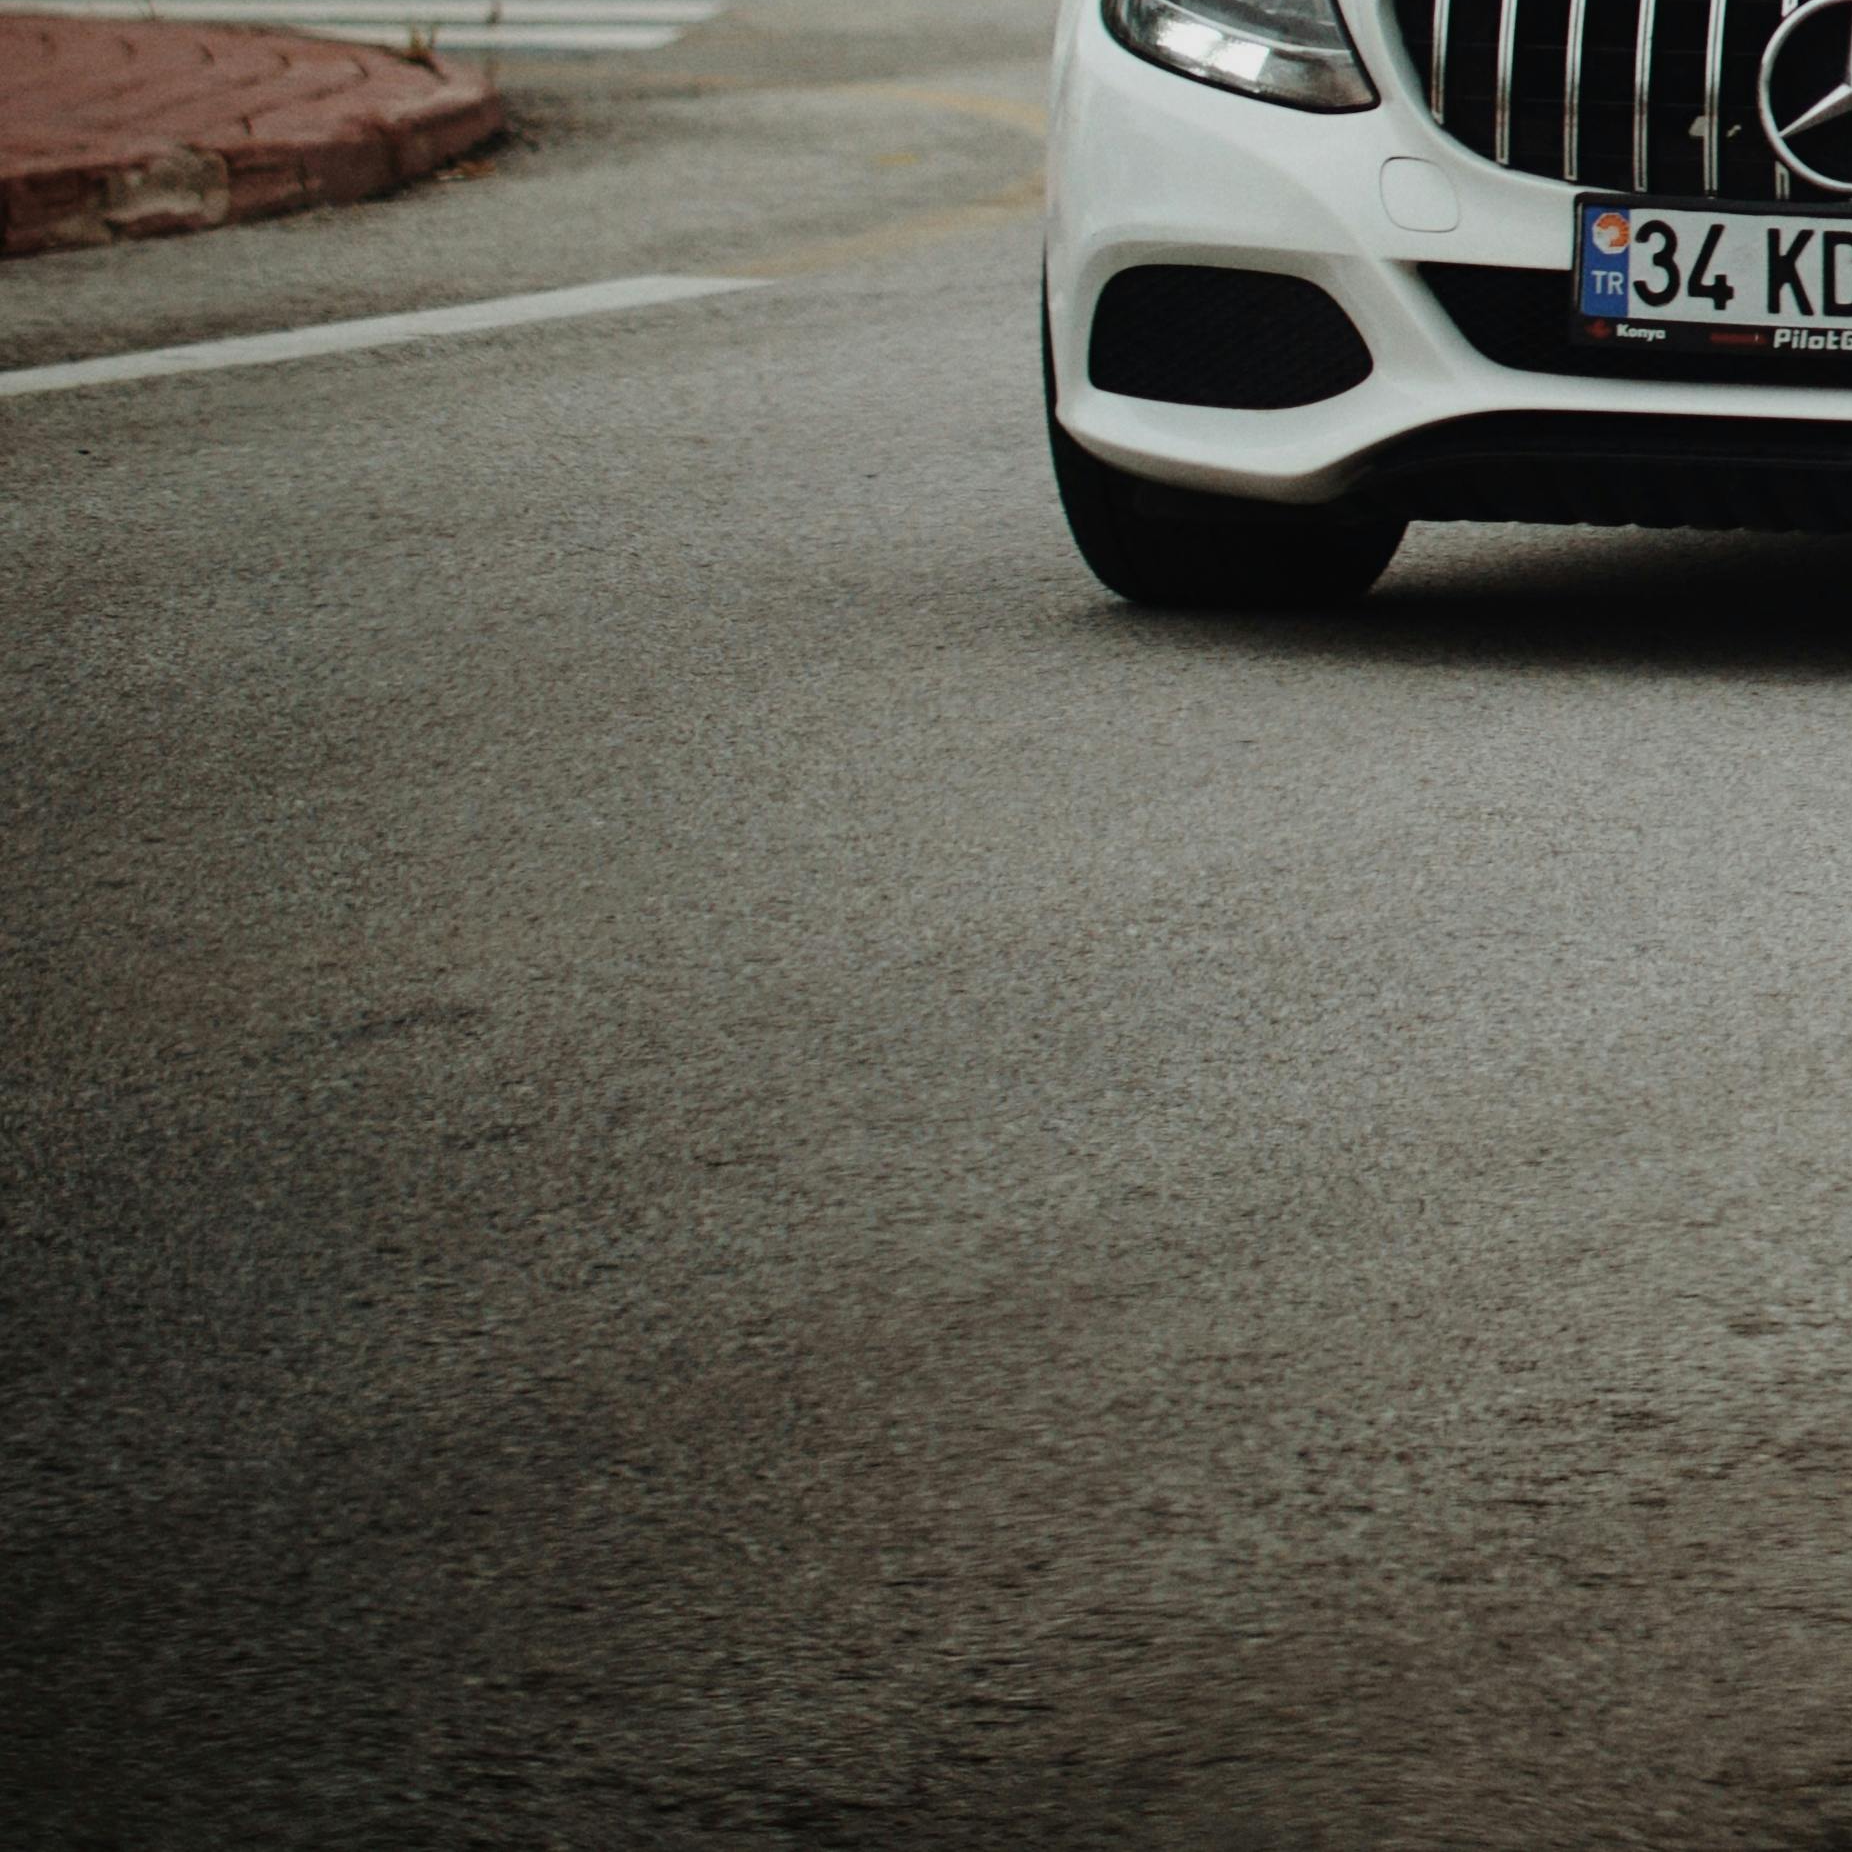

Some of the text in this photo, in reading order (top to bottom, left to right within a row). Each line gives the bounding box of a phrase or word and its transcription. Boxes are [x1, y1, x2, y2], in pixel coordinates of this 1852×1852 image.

[1632, 219, 1735, 311] 34
[1592, 269, 1625, 296] TR
[1615, 323, 1667, 342] Konya
